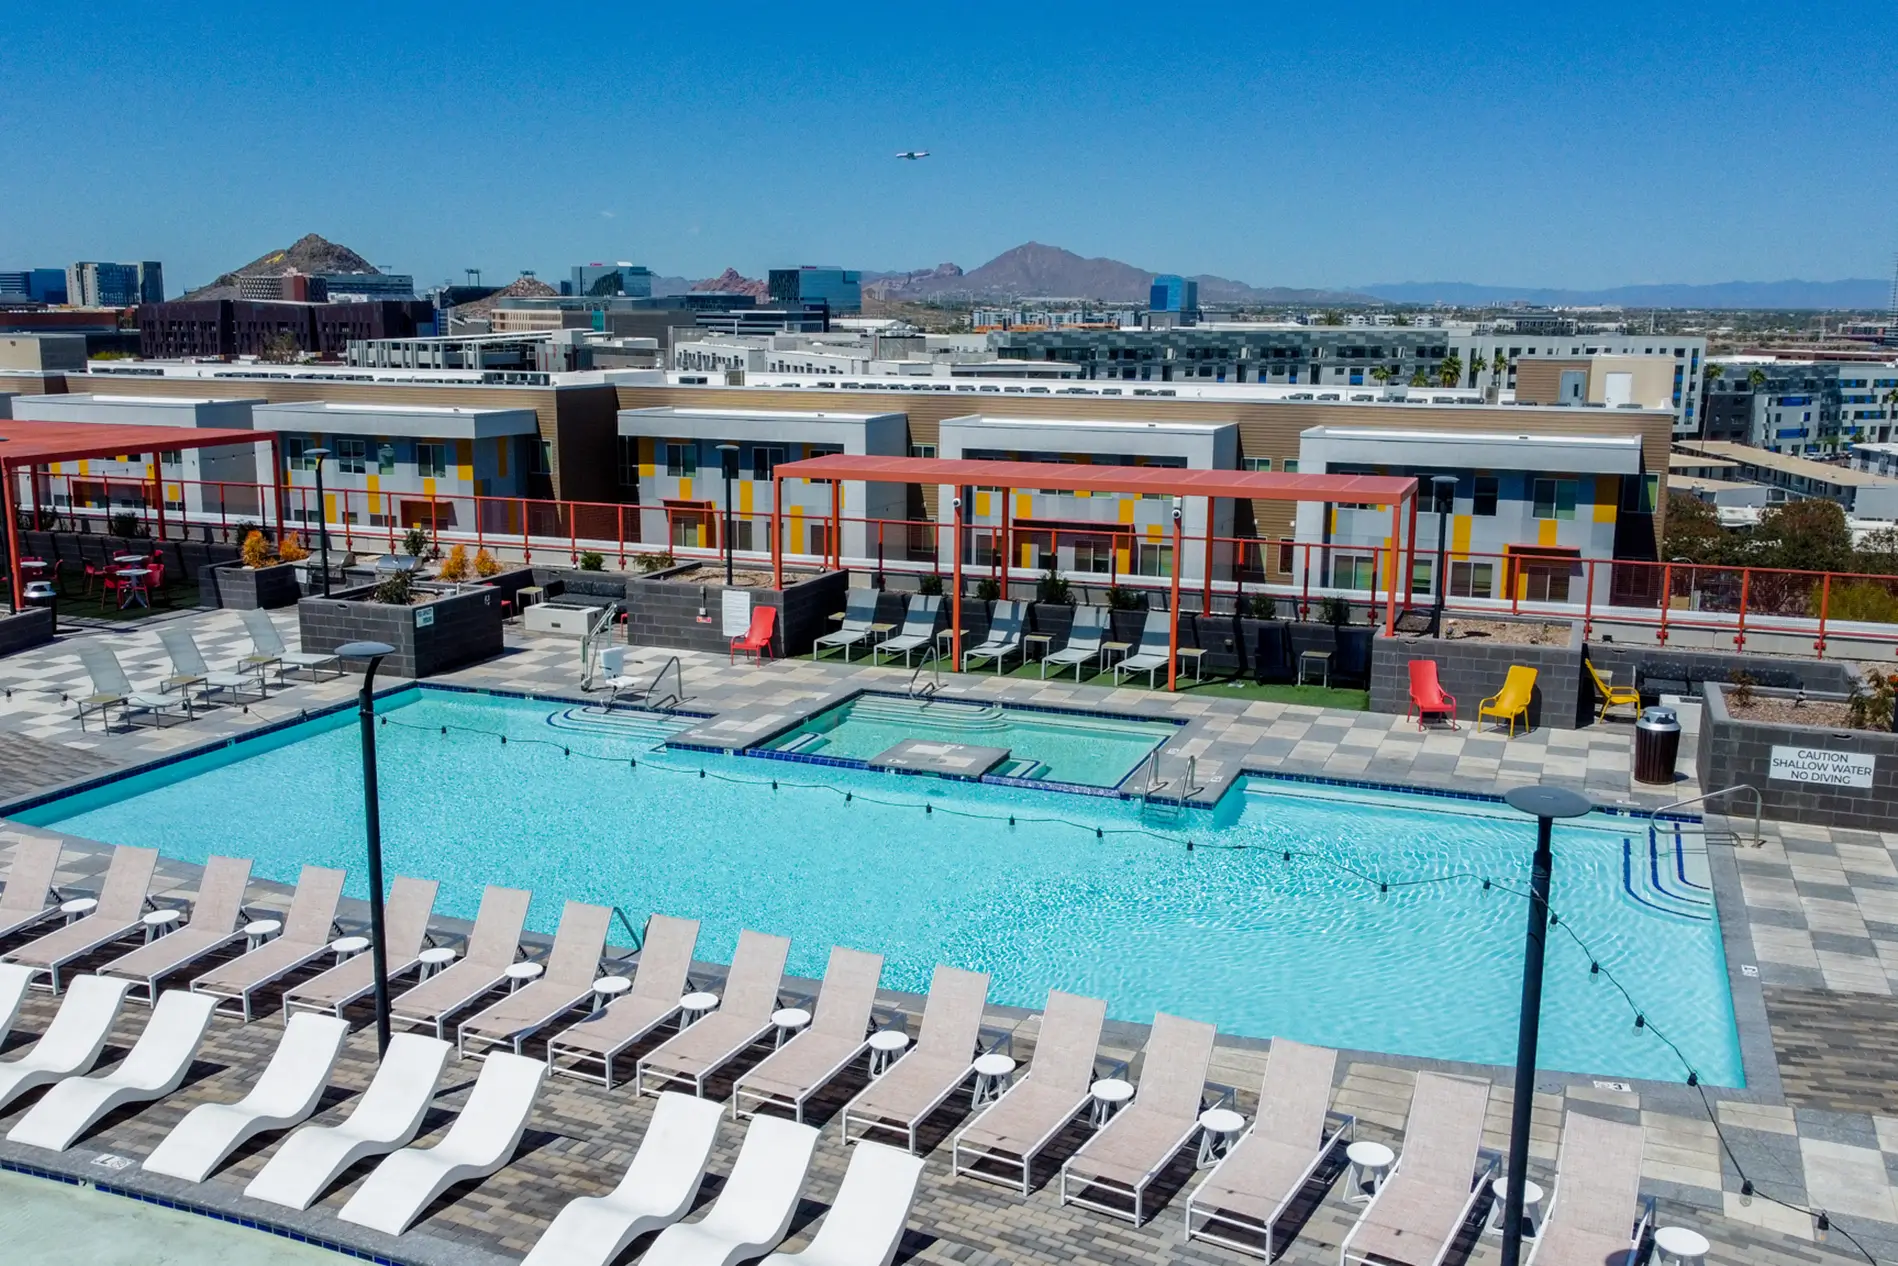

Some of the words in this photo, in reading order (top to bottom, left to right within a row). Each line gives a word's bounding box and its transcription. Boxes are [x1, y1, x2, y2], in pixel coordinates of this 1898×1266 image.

[1798, 750, 1848, 763] CAUTION
[1772, 758, 1829, 772] SHALLOW
[1832, 764, 1872, 776] WATER
[1791, 771, 1808, 780] NO
[1811, 772, 1851, 784] DIVING
